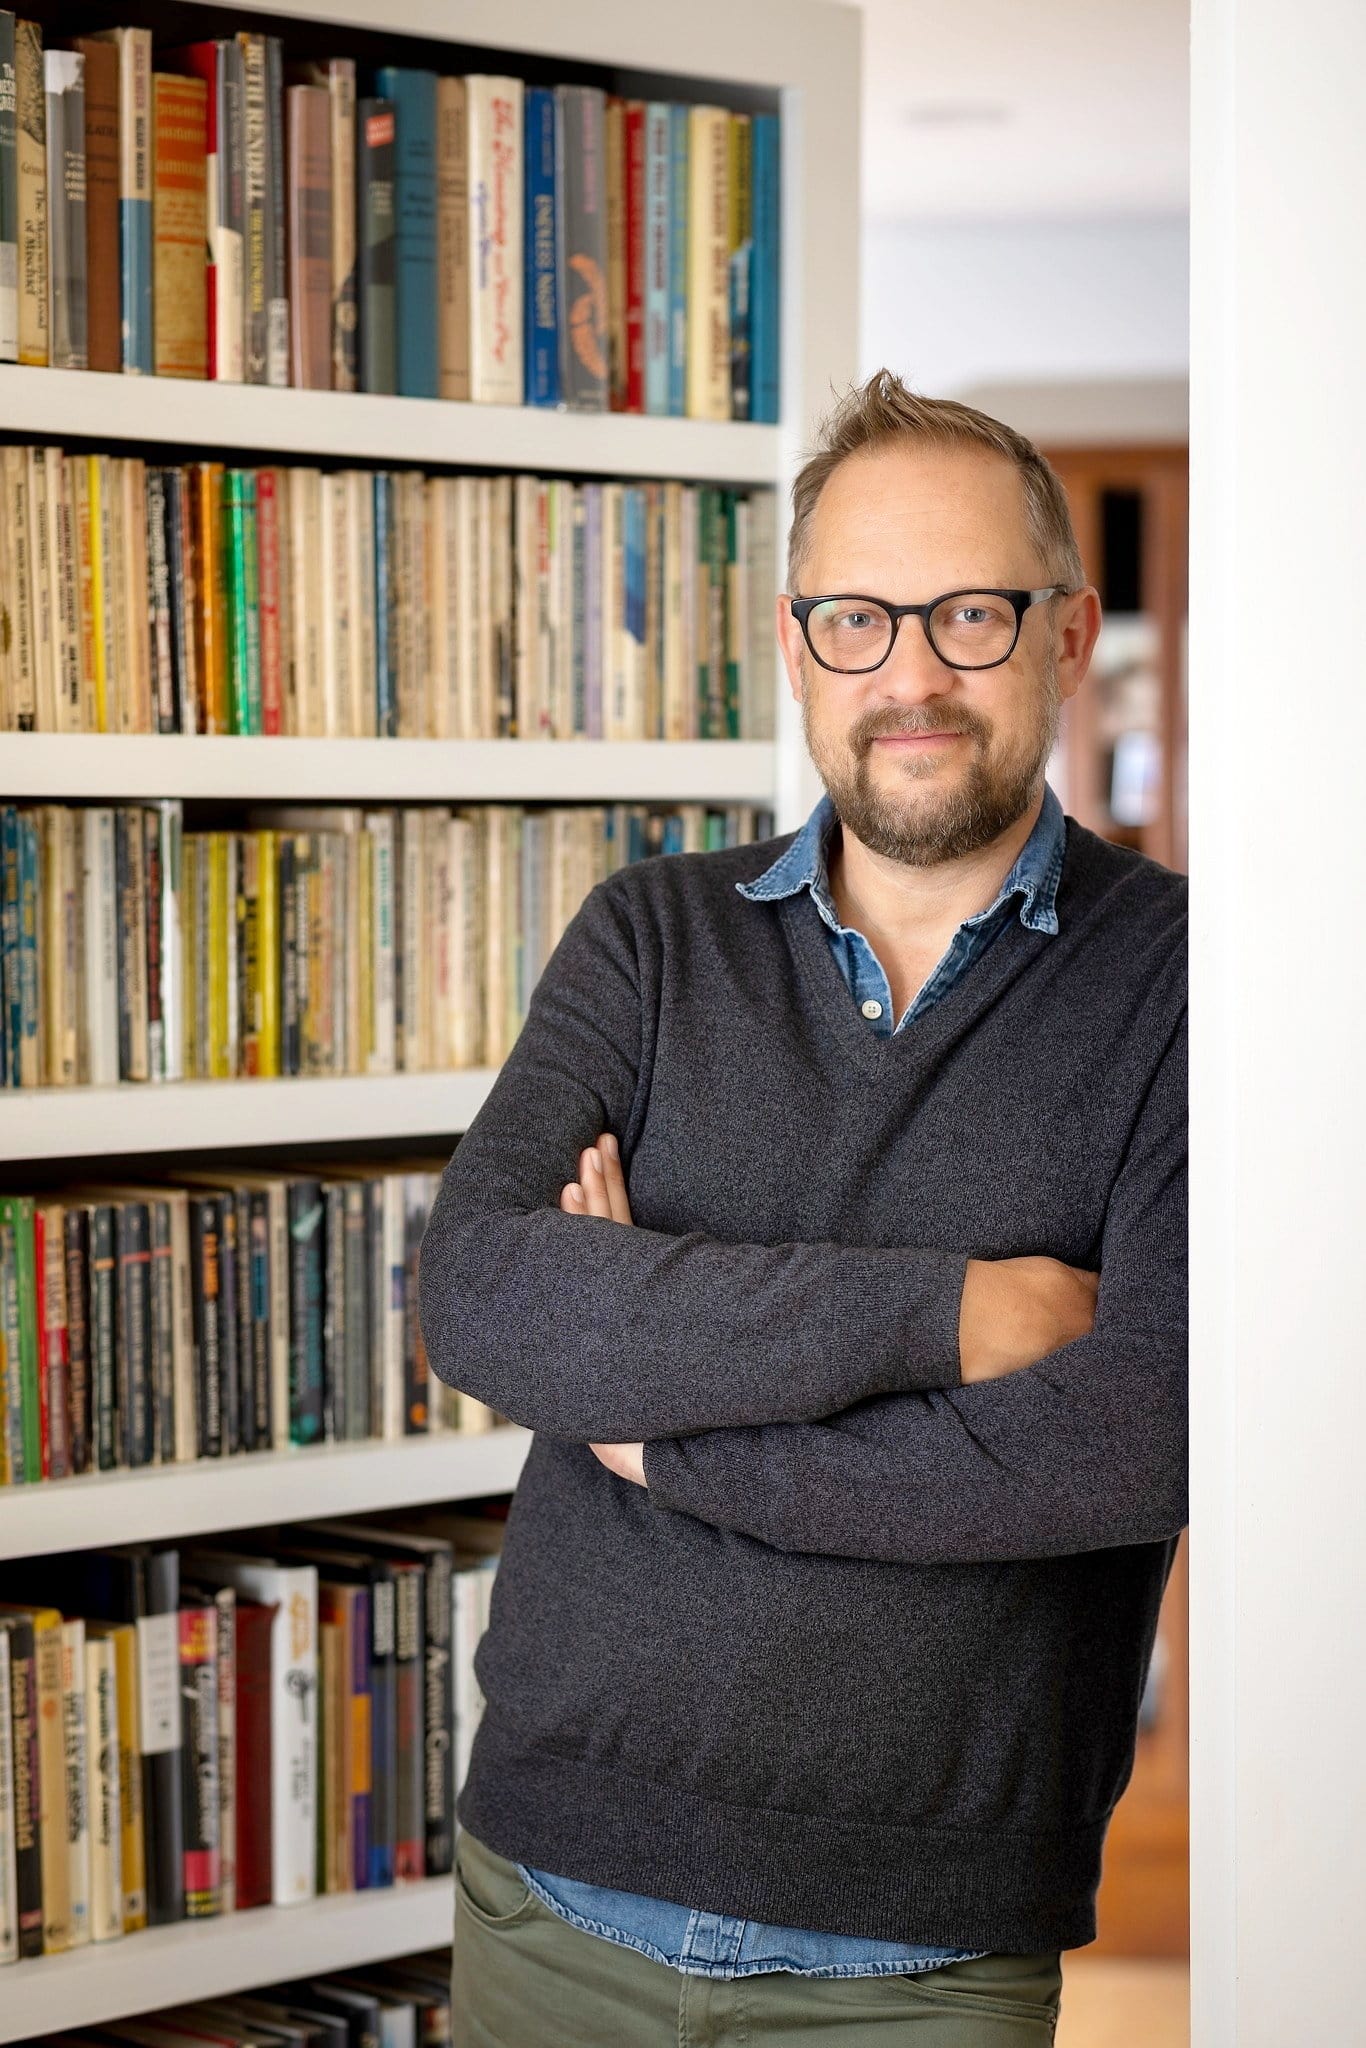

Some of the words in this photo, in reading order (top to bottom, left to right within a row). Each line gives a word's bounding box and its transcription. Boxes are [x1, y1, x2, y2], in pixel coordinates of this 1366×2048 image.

[246, 42, 266, 103] RUTH
[246, 108, 265, 202] RENDELL
[12, 1659, 29, 1715] Ross
[14, 1718, 34, 1849] Macdonald
